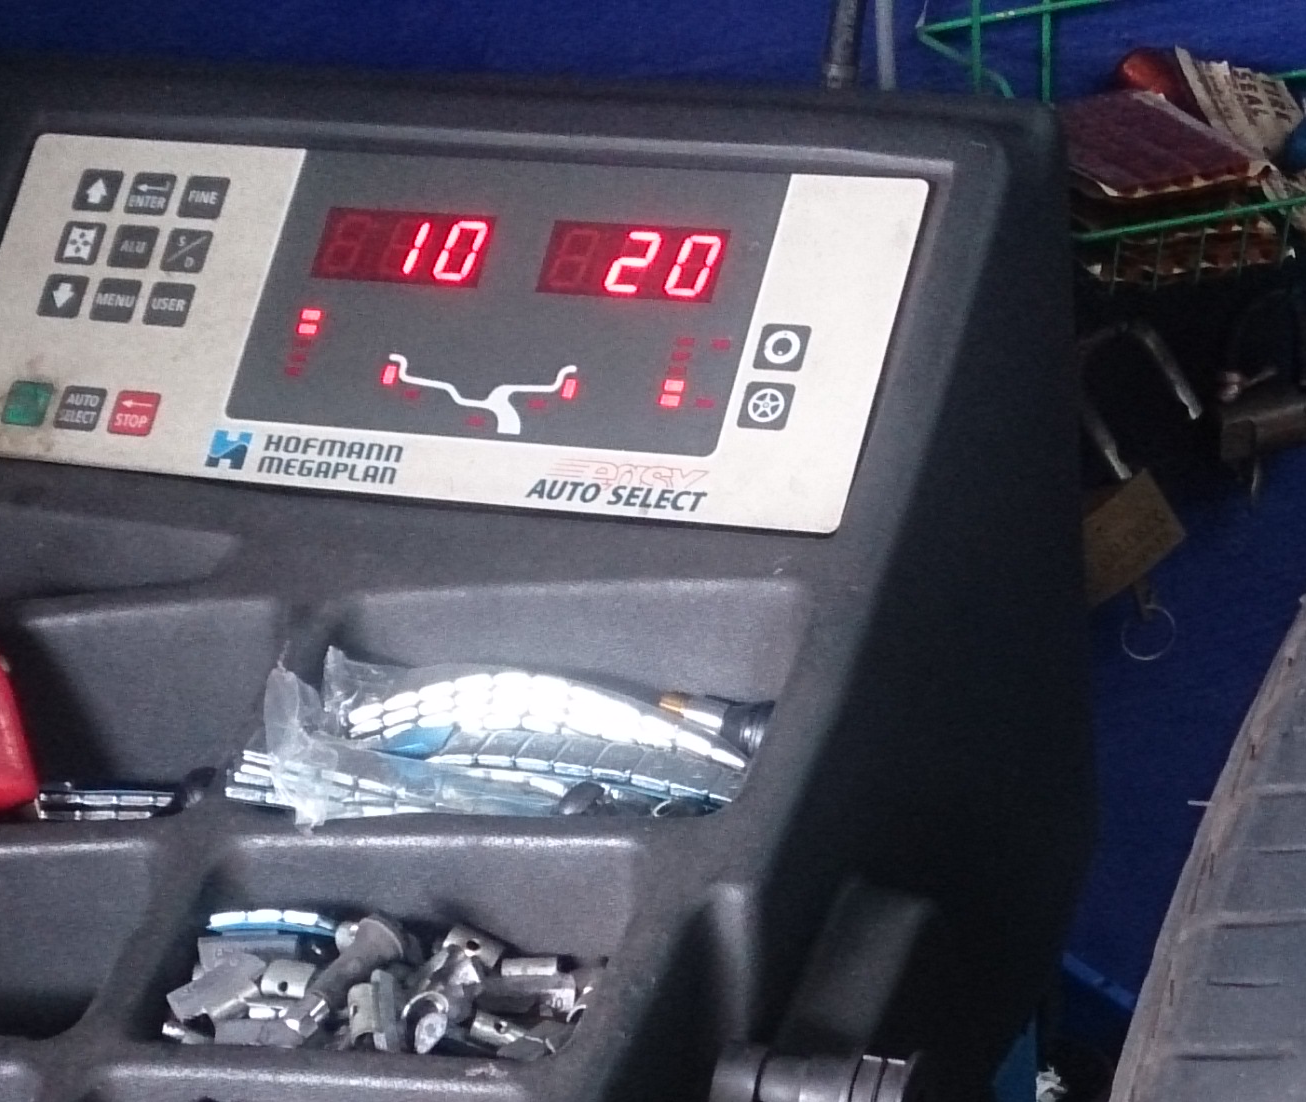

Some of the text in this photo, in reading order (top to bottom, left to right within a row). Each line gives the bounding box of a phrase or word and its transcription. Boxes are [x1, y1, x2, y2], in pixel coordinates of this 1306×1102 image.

[128, 195, 166, 209] ENTER
[188, 190, 218, 205] FINE
[120, 240, 147, 254] ALU
[402, 220, 489, 282] 10
[603, 231, 722, 298] 20
[96, 293, 135, 308] MENU
[151, 299, 186, 312] USER
[65, 393, 100, 407] AUTO
[114, 413, 148, 428] STOP
[264, 434, 404, 463] HOFMANN
[257, 456, 397, 484] MEGAPLAN
[525, 478, 708, 512] AUTO SELECT
